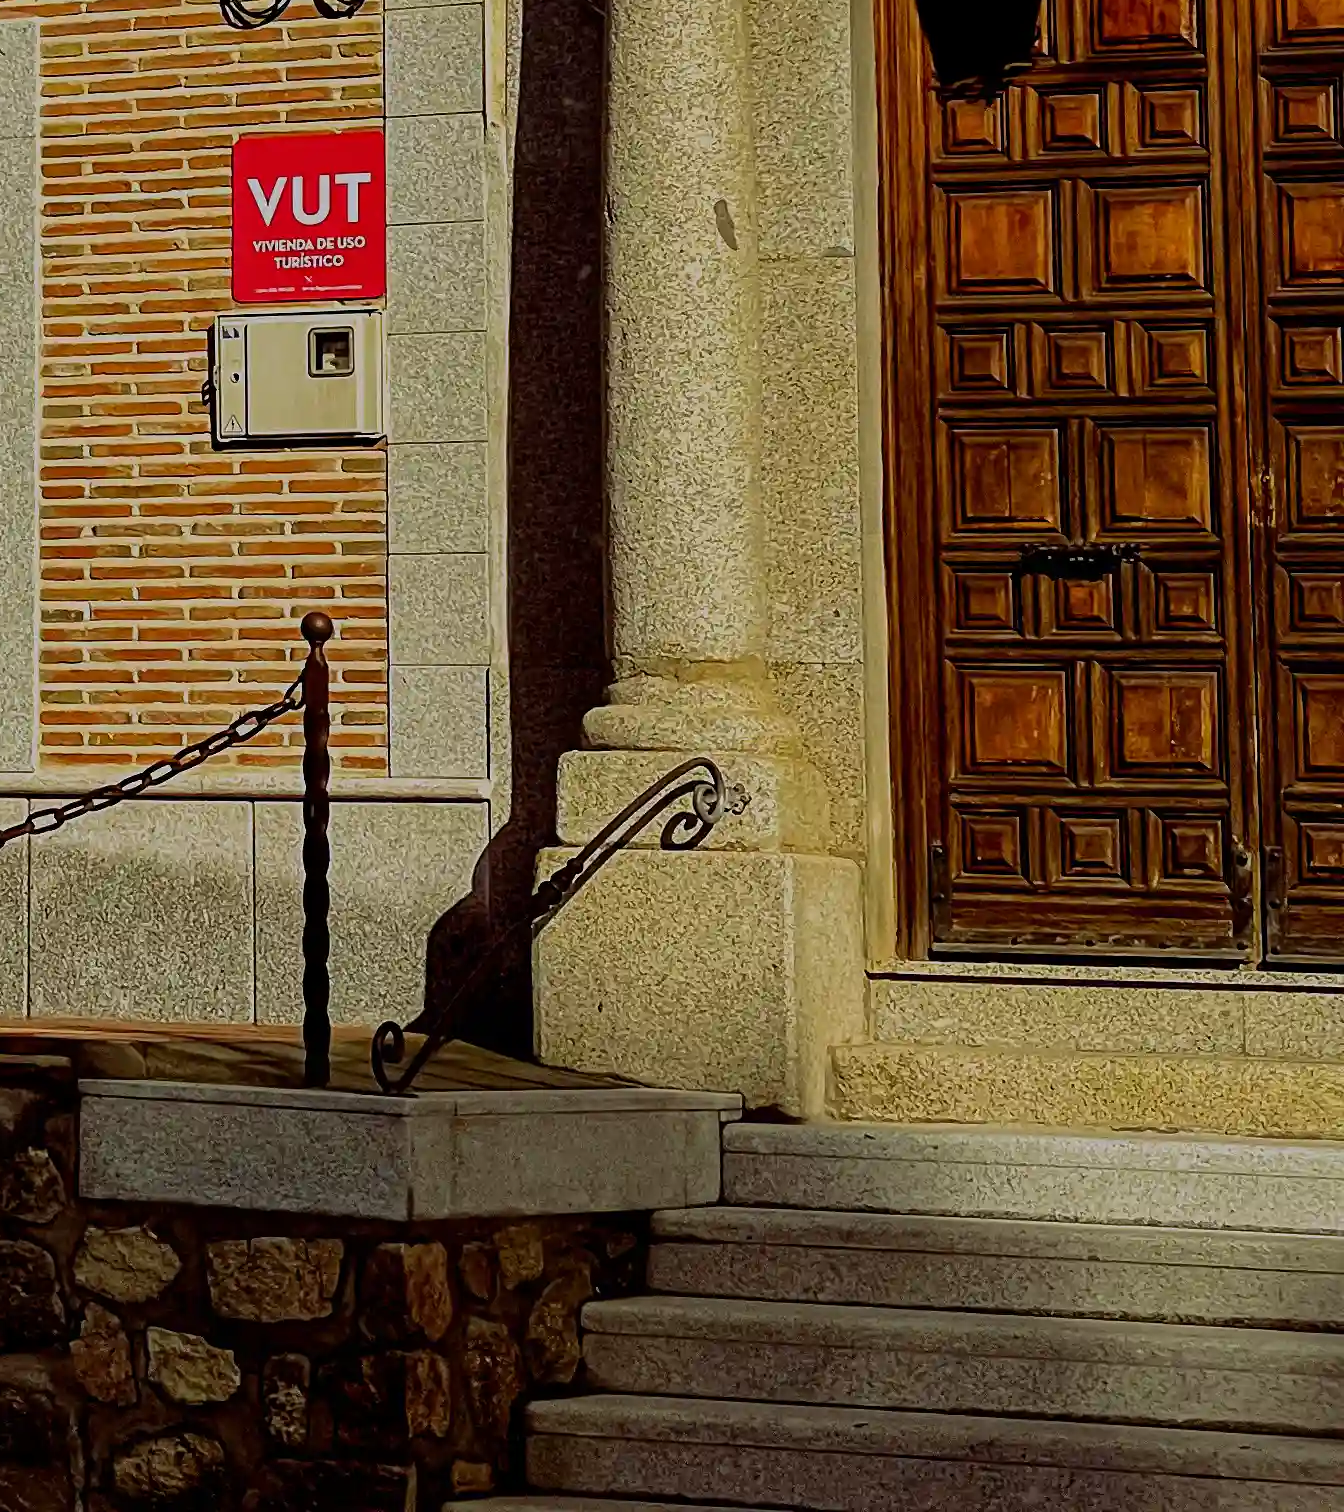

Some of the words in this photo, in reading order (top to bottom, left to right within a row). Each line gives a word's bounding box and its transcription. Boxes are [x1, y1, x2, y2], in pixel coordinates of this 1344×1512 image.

[247, 172, 372, 226] VUT
[253, 238, 315, 253] VIVIENDA
[316, 236, 335, 250] DE
[337, 235, 366, 249] USO
[273, 252, 345, 269] TURÍSTICO
